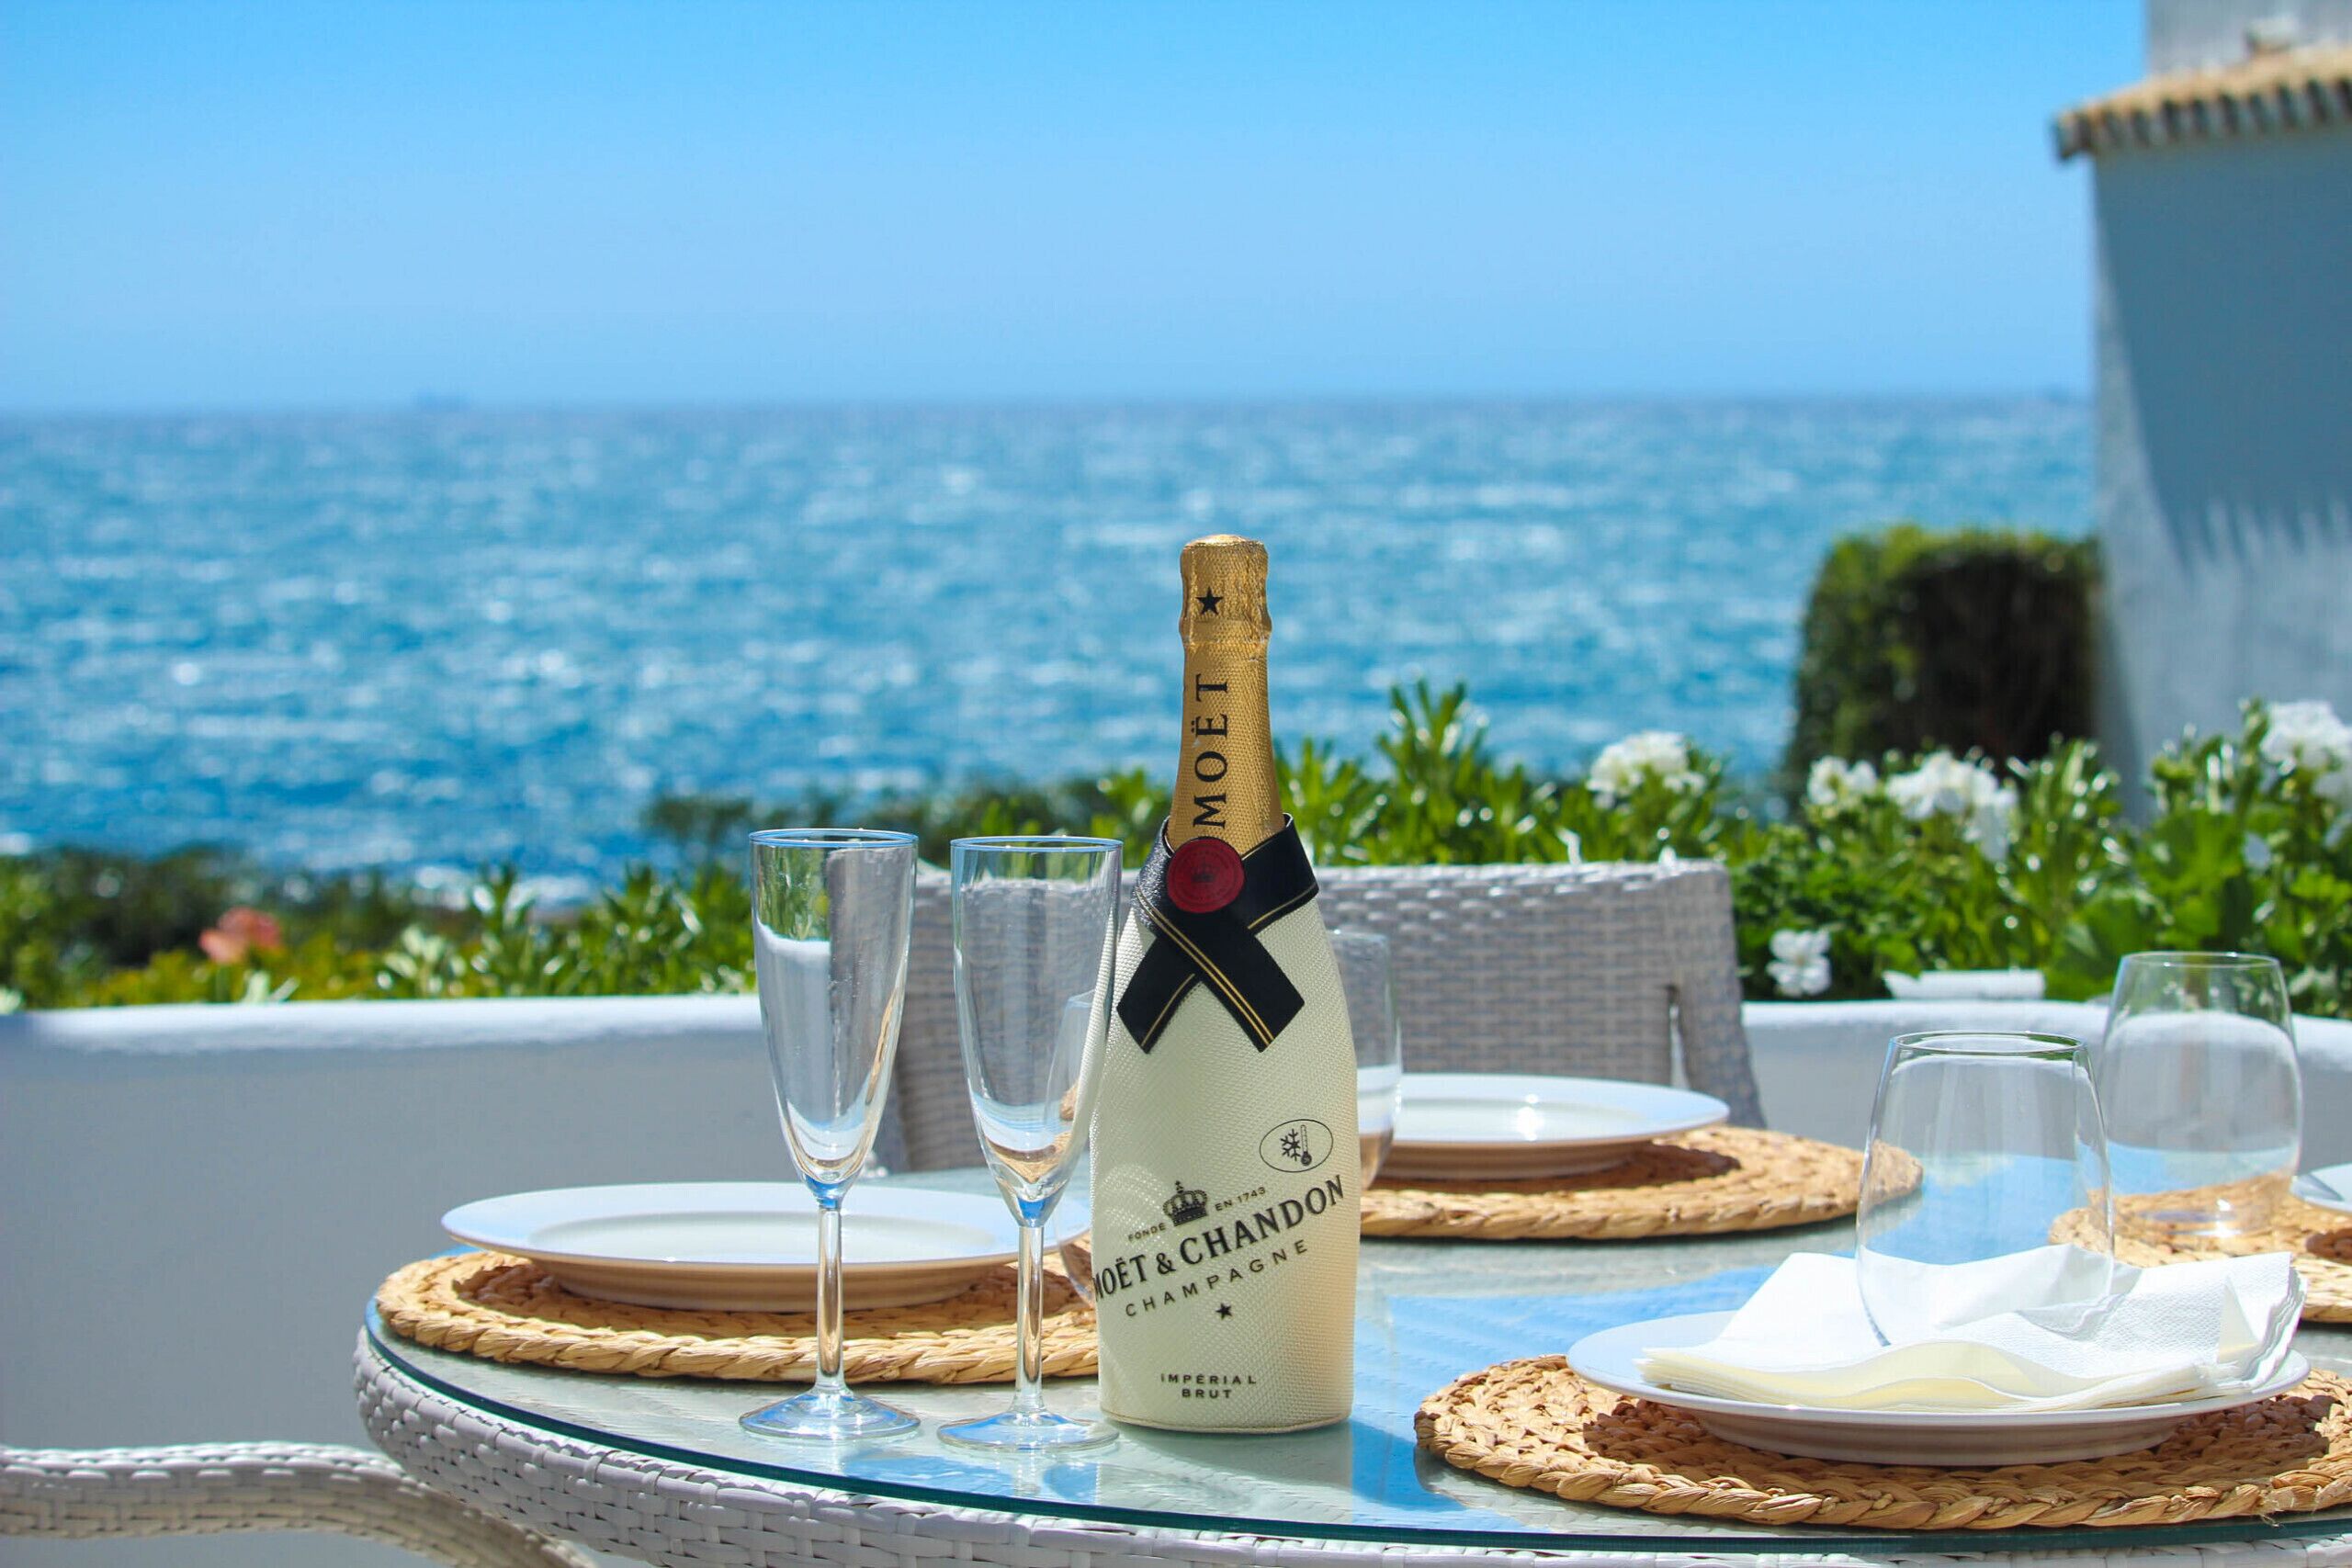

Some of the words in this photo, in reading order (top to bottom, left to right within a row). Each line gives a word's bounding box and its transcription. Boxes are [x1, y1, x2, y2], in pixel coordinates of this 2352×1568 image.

[1191, 673, 1228, 829] MOËT
[1157, 1252, 1177, 1275] &
[1179, 1175, 1345, 1266] CHANDON
[1215, 1200, 1233, 1212] EN
[1238, 1186, 1266, 1203] 1743
[1125, 1239, 1308, 1316] CHAMPAGNE
[1182, 1388, 1232, 1399] BRUT
